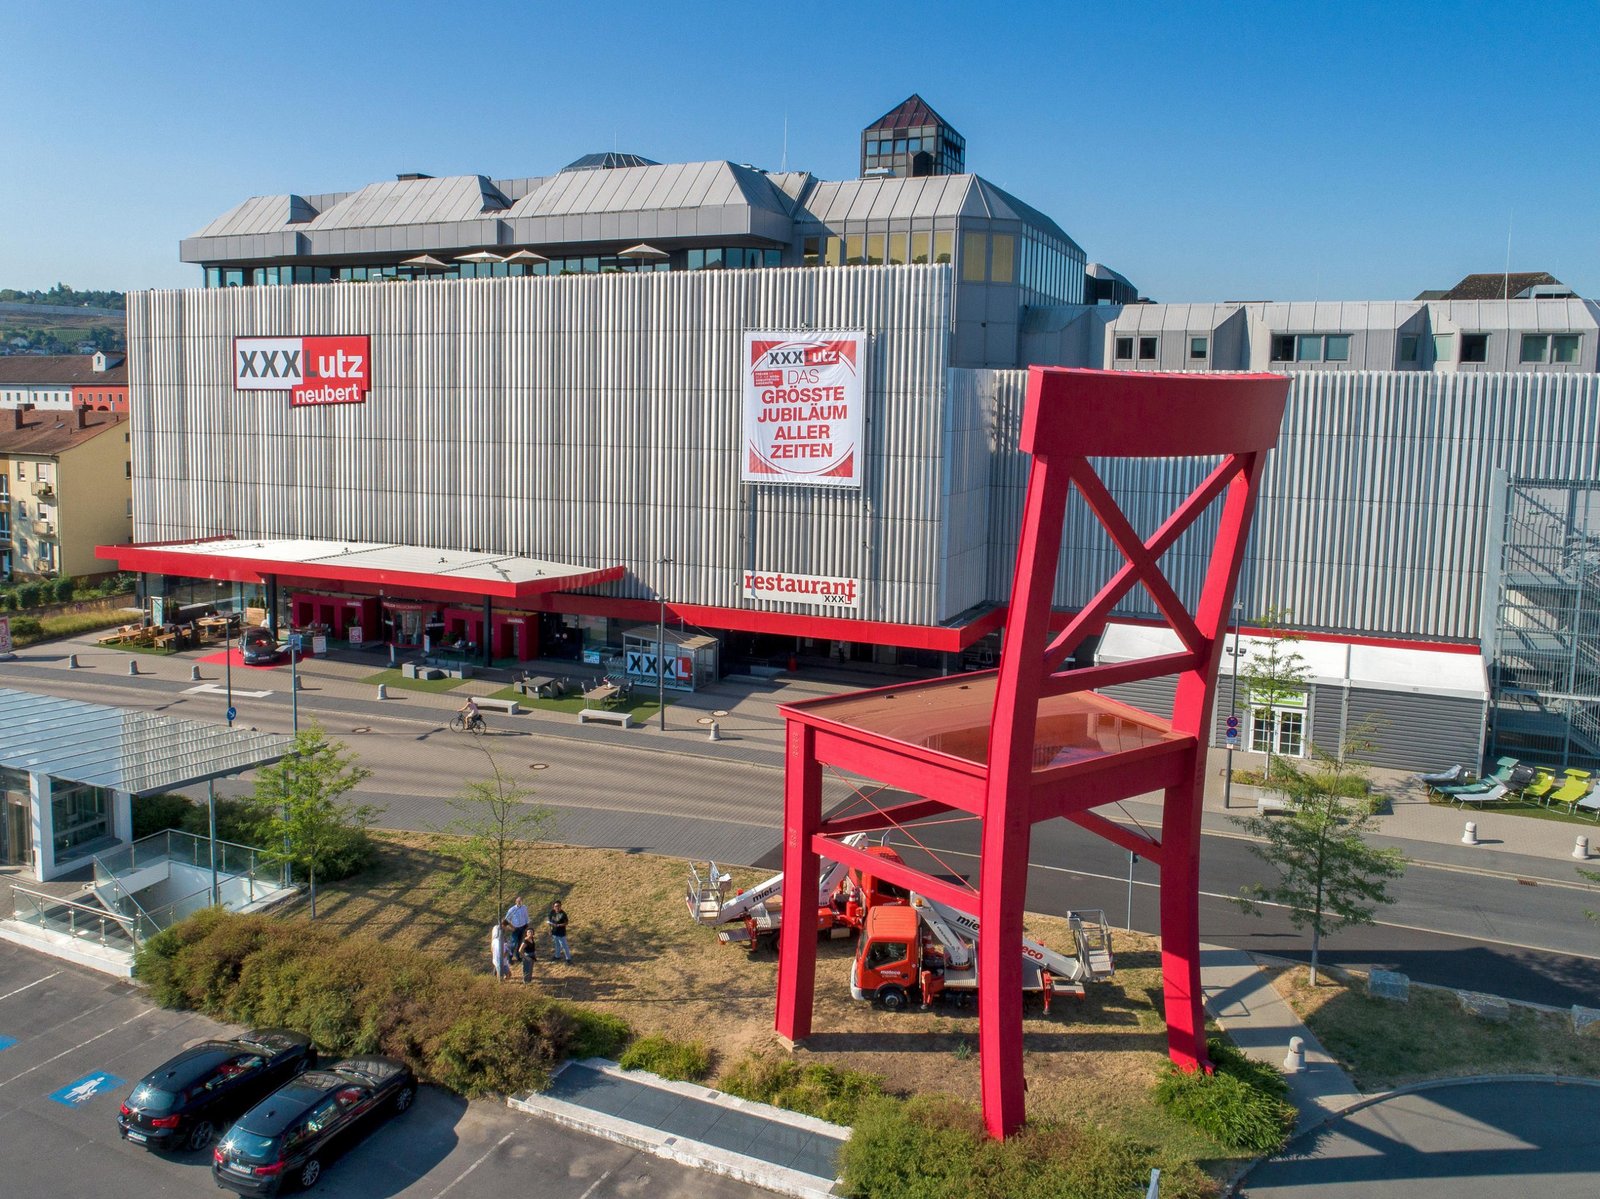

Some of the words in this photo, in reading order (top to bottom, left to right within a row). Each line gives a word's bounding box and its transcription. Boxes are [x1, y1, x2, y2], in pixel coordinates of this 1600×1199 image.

[239, 349, 363, 379] XXXLutz
[768, 349, 837, 365] XXXLutz
[787, 369, 820, 385] DAS
[296, 383, 359, 404] neubert
[761, 386, 845, 405] GRÖSSTE
[757, 403, 848, 423] JUBILÄUM
[774, 424, 831, 441] ALLER
[770, 443, 833, 459] ZEITEN
[745, 574, 856, 600] restaurant
[629, 655, 689, 678] XXXL
